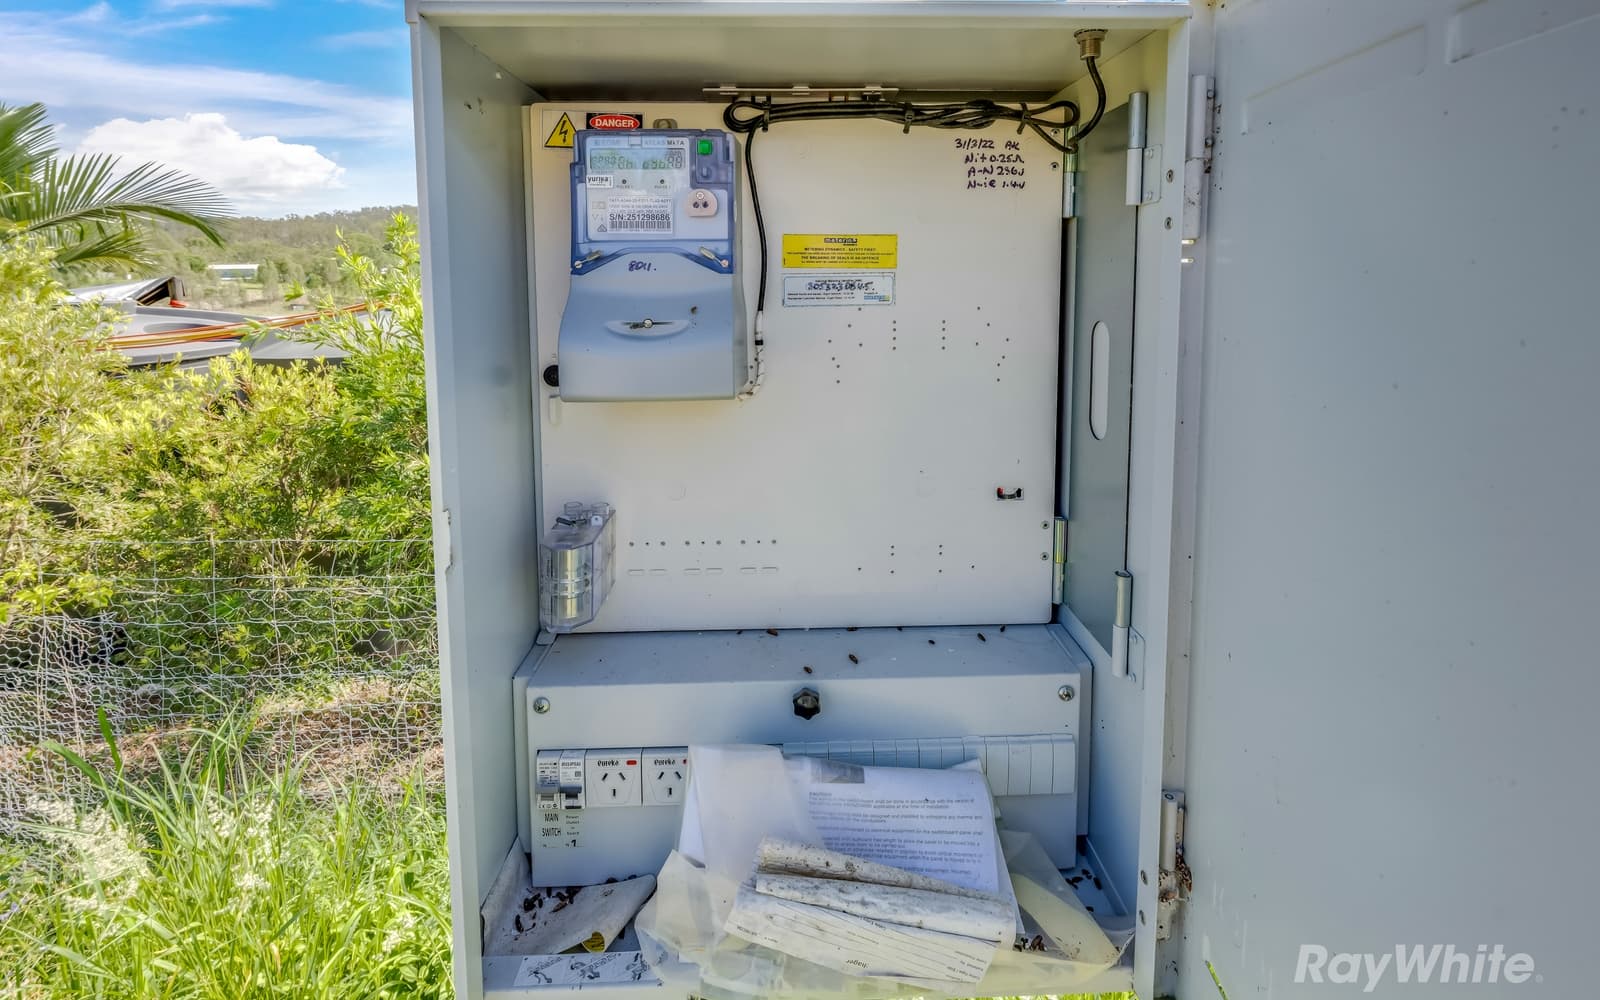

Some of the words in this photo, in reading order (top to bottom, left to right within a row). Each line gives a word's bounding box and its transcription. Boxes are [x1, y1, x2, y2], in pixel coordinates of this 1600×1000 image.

[594, 118, 635, 128] DANGER
[954, 138, 995, 150] 31/3/22
[609, 213, 671, 221] S/N:251298686
[544, 813, 559, 822] MAIN
[541, 827, 562, 837] SWITCH
